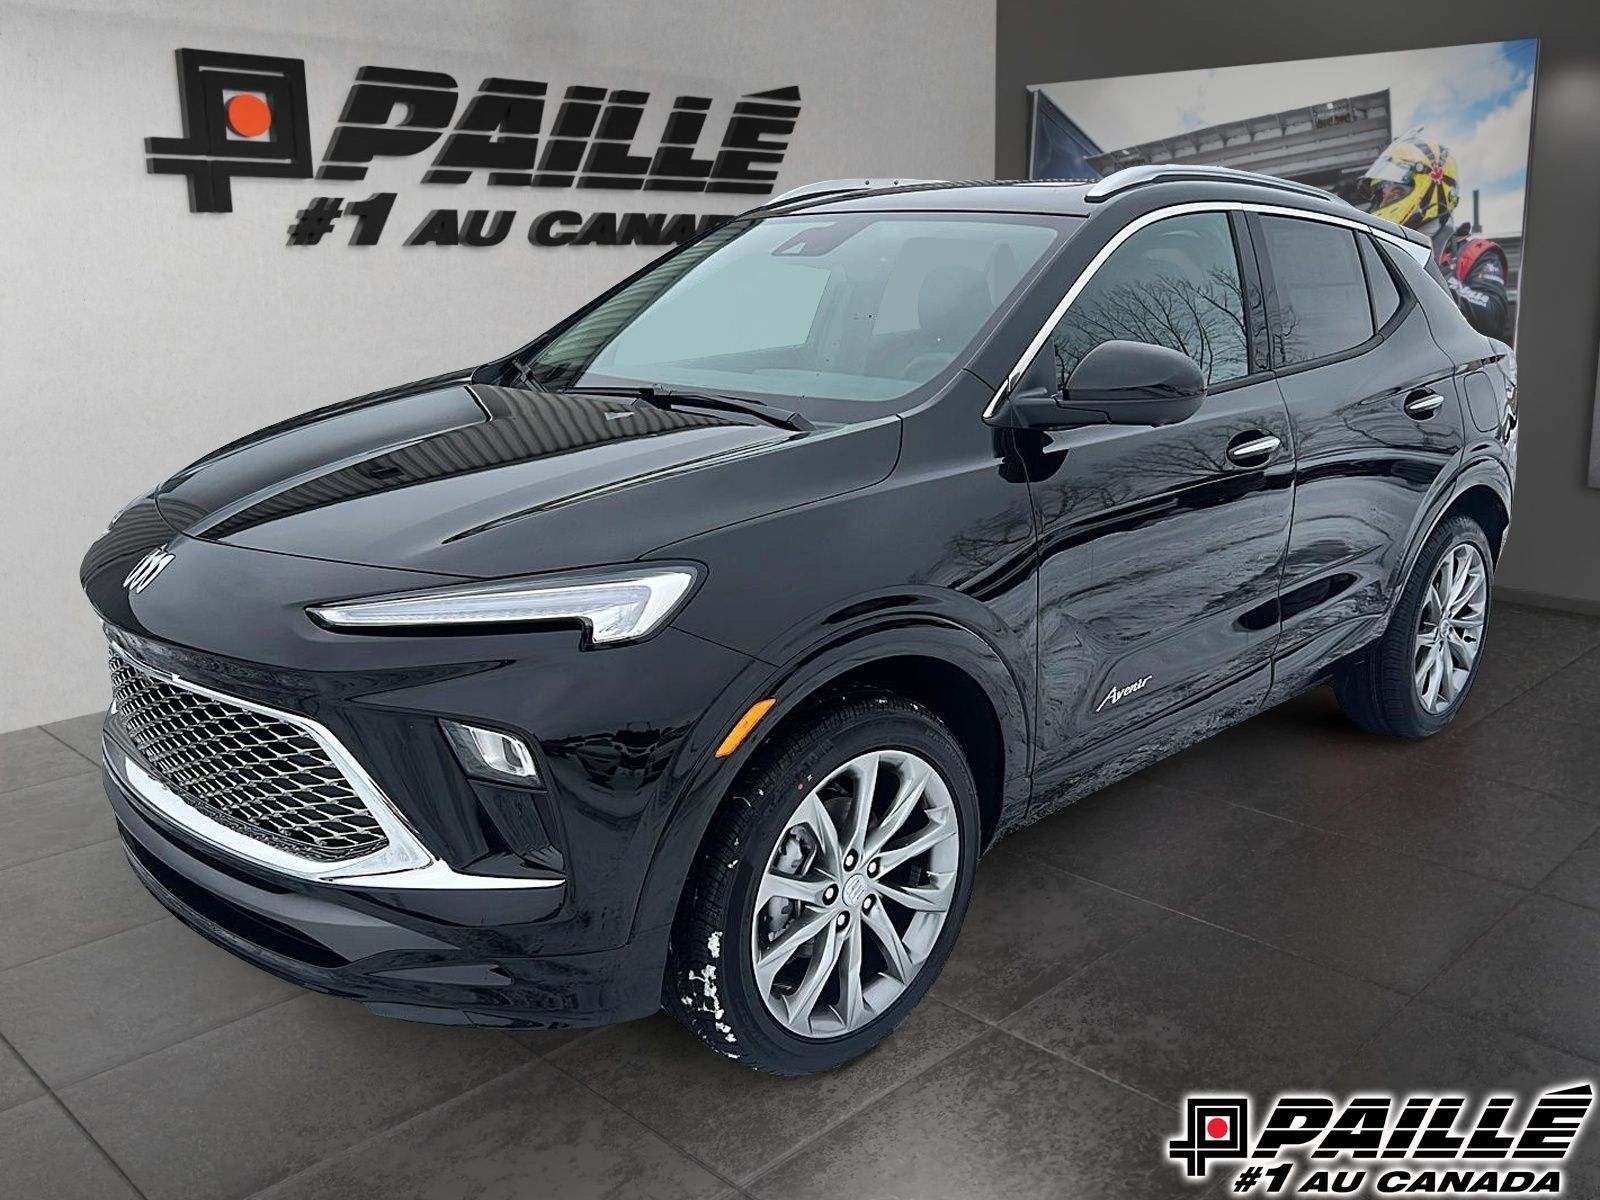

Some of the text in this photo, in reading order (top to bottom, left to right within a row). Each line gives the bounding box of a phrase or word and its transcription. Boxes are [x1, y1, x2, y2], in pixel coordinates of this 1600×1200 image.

[315, 65, 801, 195] PAILLÉ
[286, 193, 398, 246] #1
[402, 209, 517, 247] AU
[1096, 675, 1152, 712] Avenir
